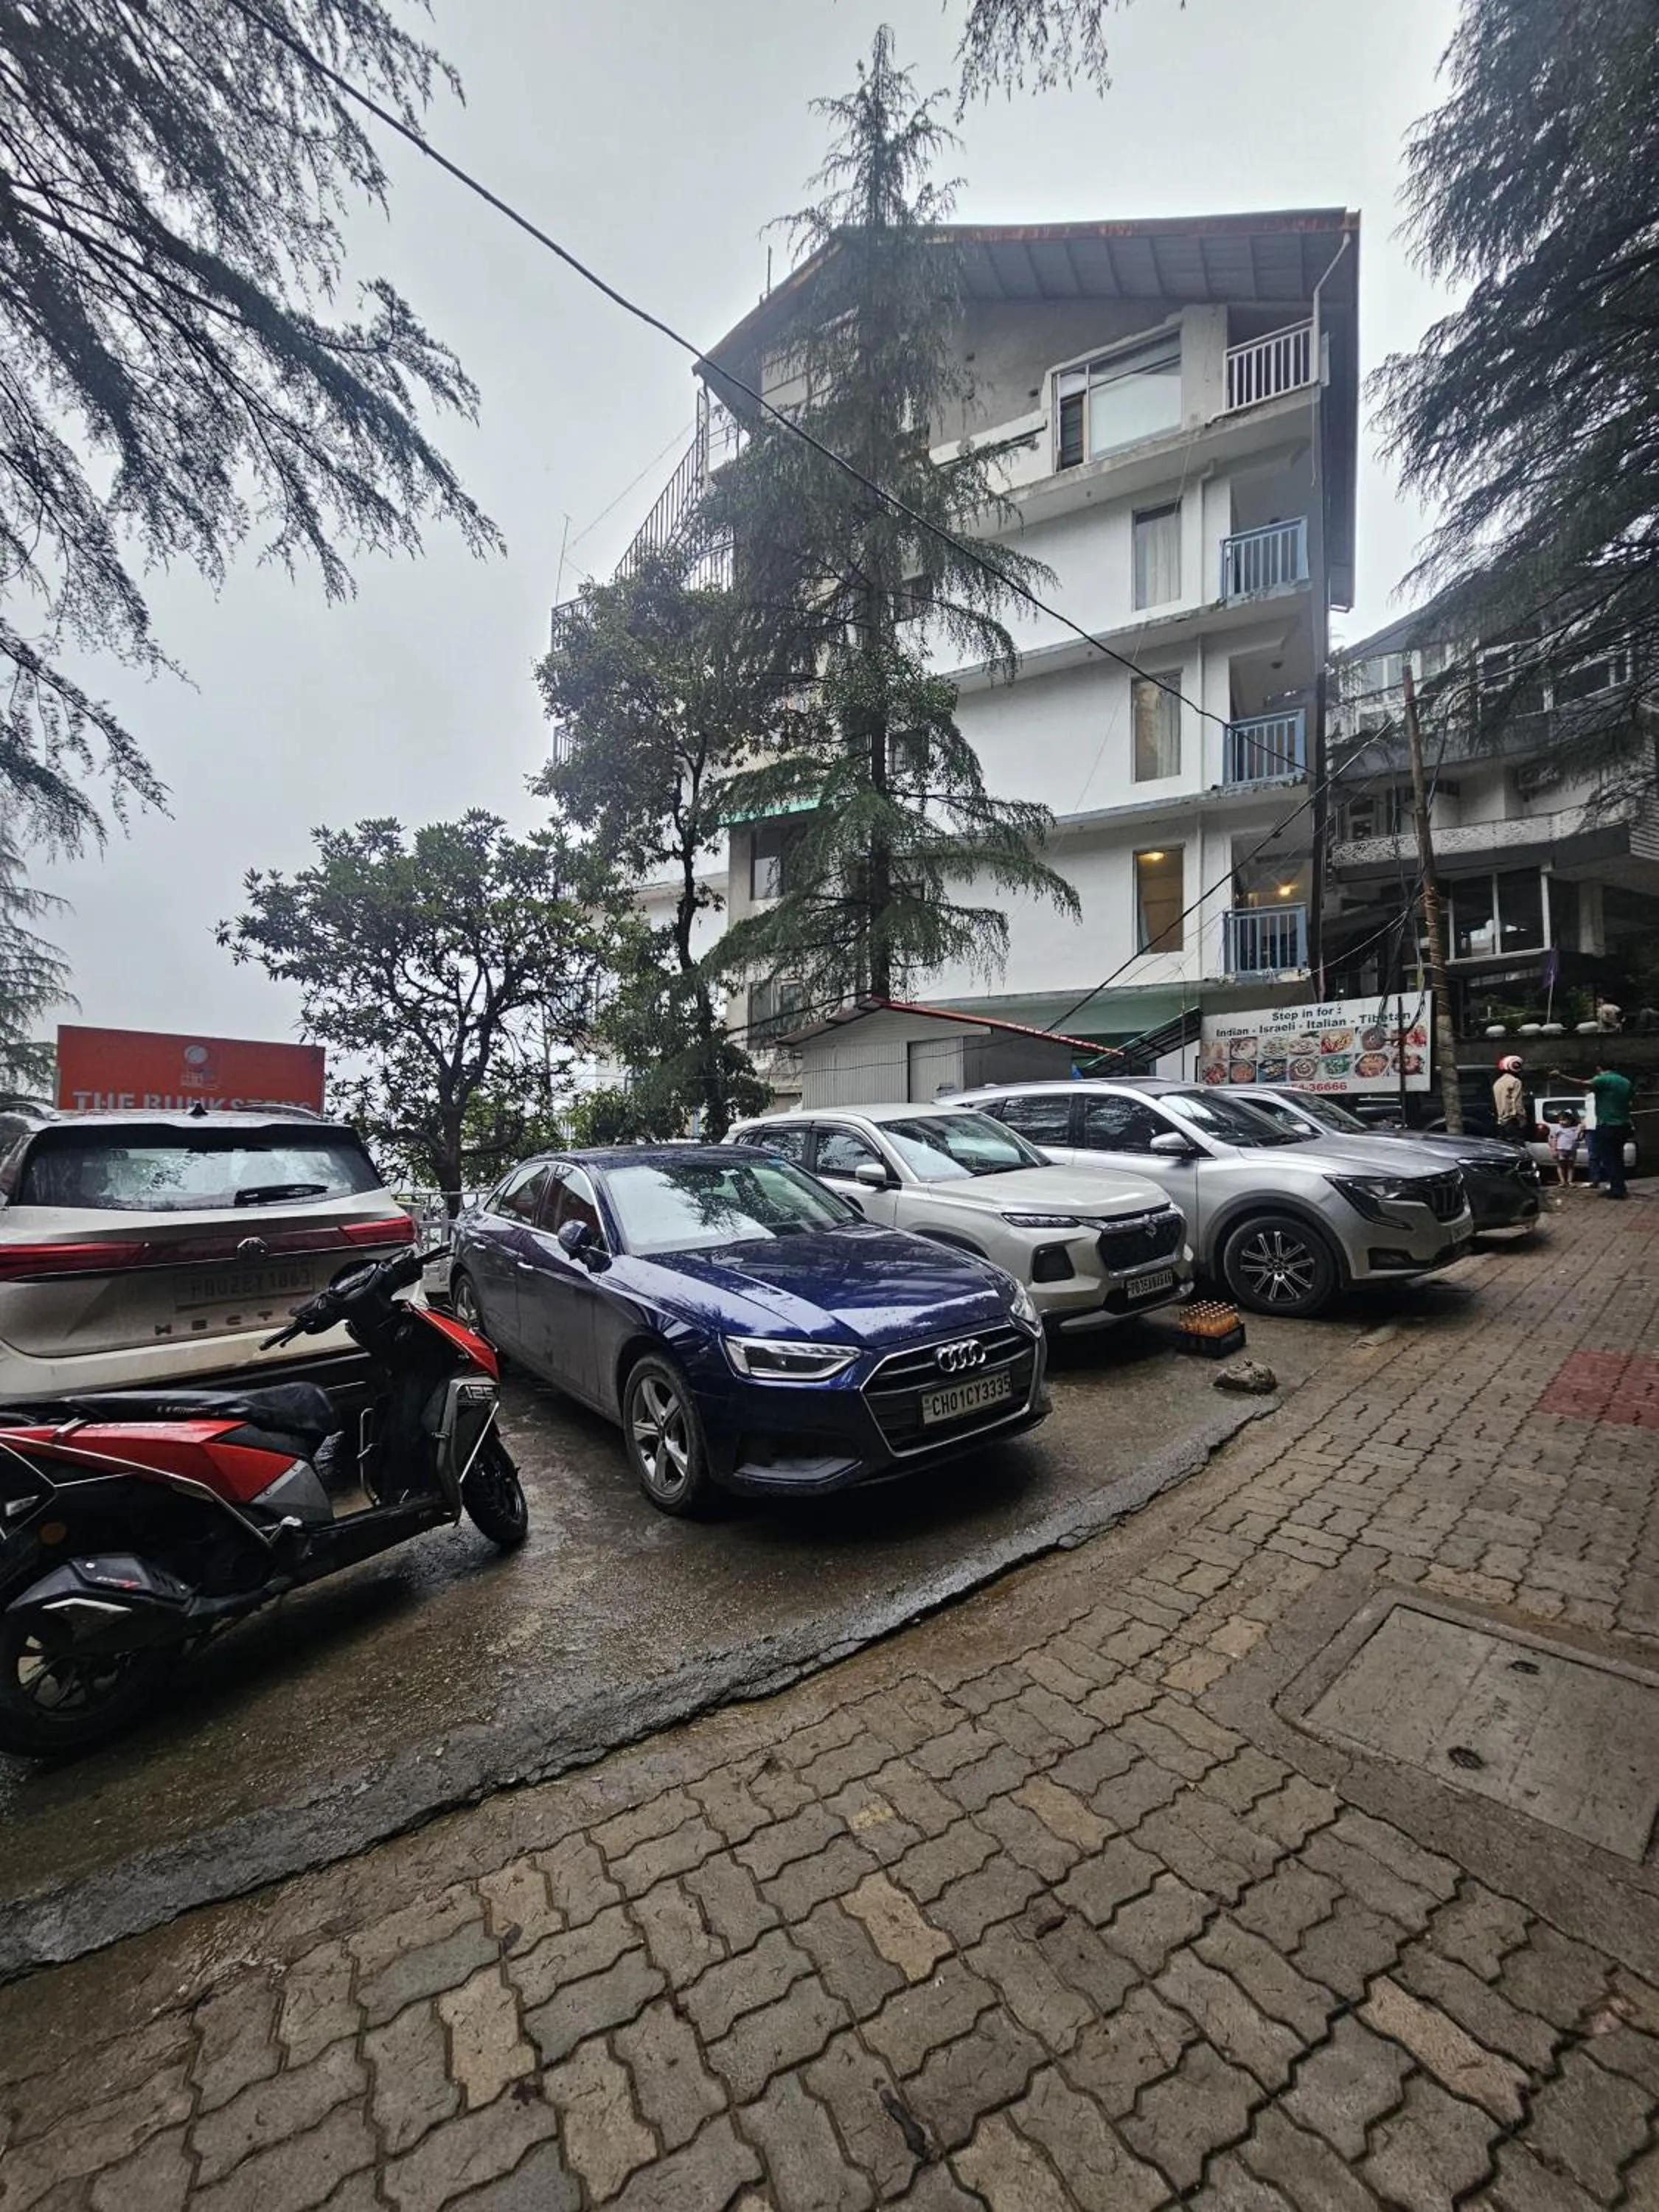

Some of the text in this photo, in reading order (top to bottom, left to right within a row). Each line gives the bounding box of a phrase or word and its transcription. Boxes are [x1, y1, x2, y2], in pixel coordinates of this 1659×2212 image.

[1301, 1009, 1313, 1018] in
[1317, 1007, 1334, 1017] for
[1216, 1028, 1249, 1037] Indian
[1259, 1022, 1295, 1033] Israeli
[1307, 1018, 1346, 1029] Italian
[1359, 1012, 1411, 1024] Tibetan
[72, 1091, 135, 1109] THE
[932, 1375, 1010, 1416] CH01CY3335
